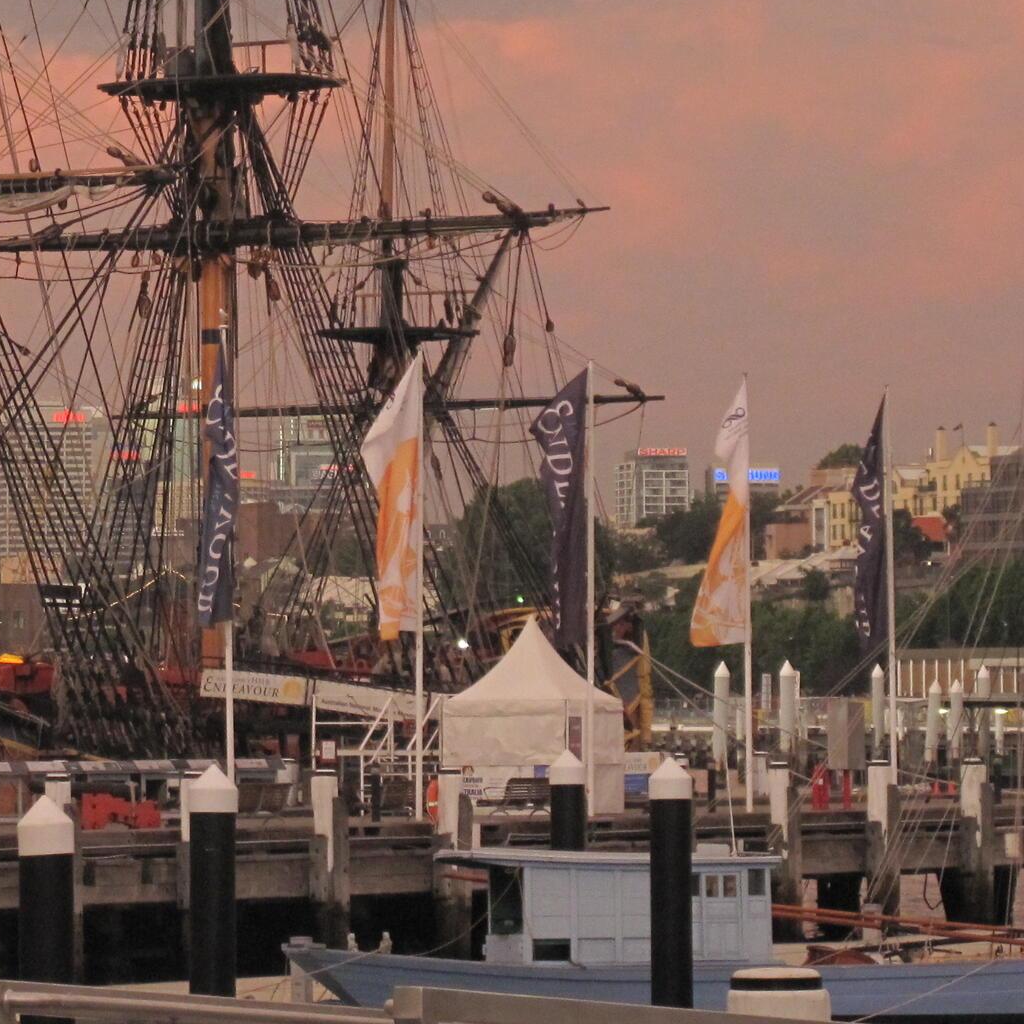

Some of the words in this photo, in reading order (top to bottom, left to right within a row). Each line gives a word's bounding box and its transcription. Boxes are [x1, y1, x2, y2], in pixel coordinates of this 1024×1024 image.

[638, 447, 687, 456] SHARP
[714, 468, 780, 481] SUNG
[203, 675, 279, 697] ENEAVOUR
